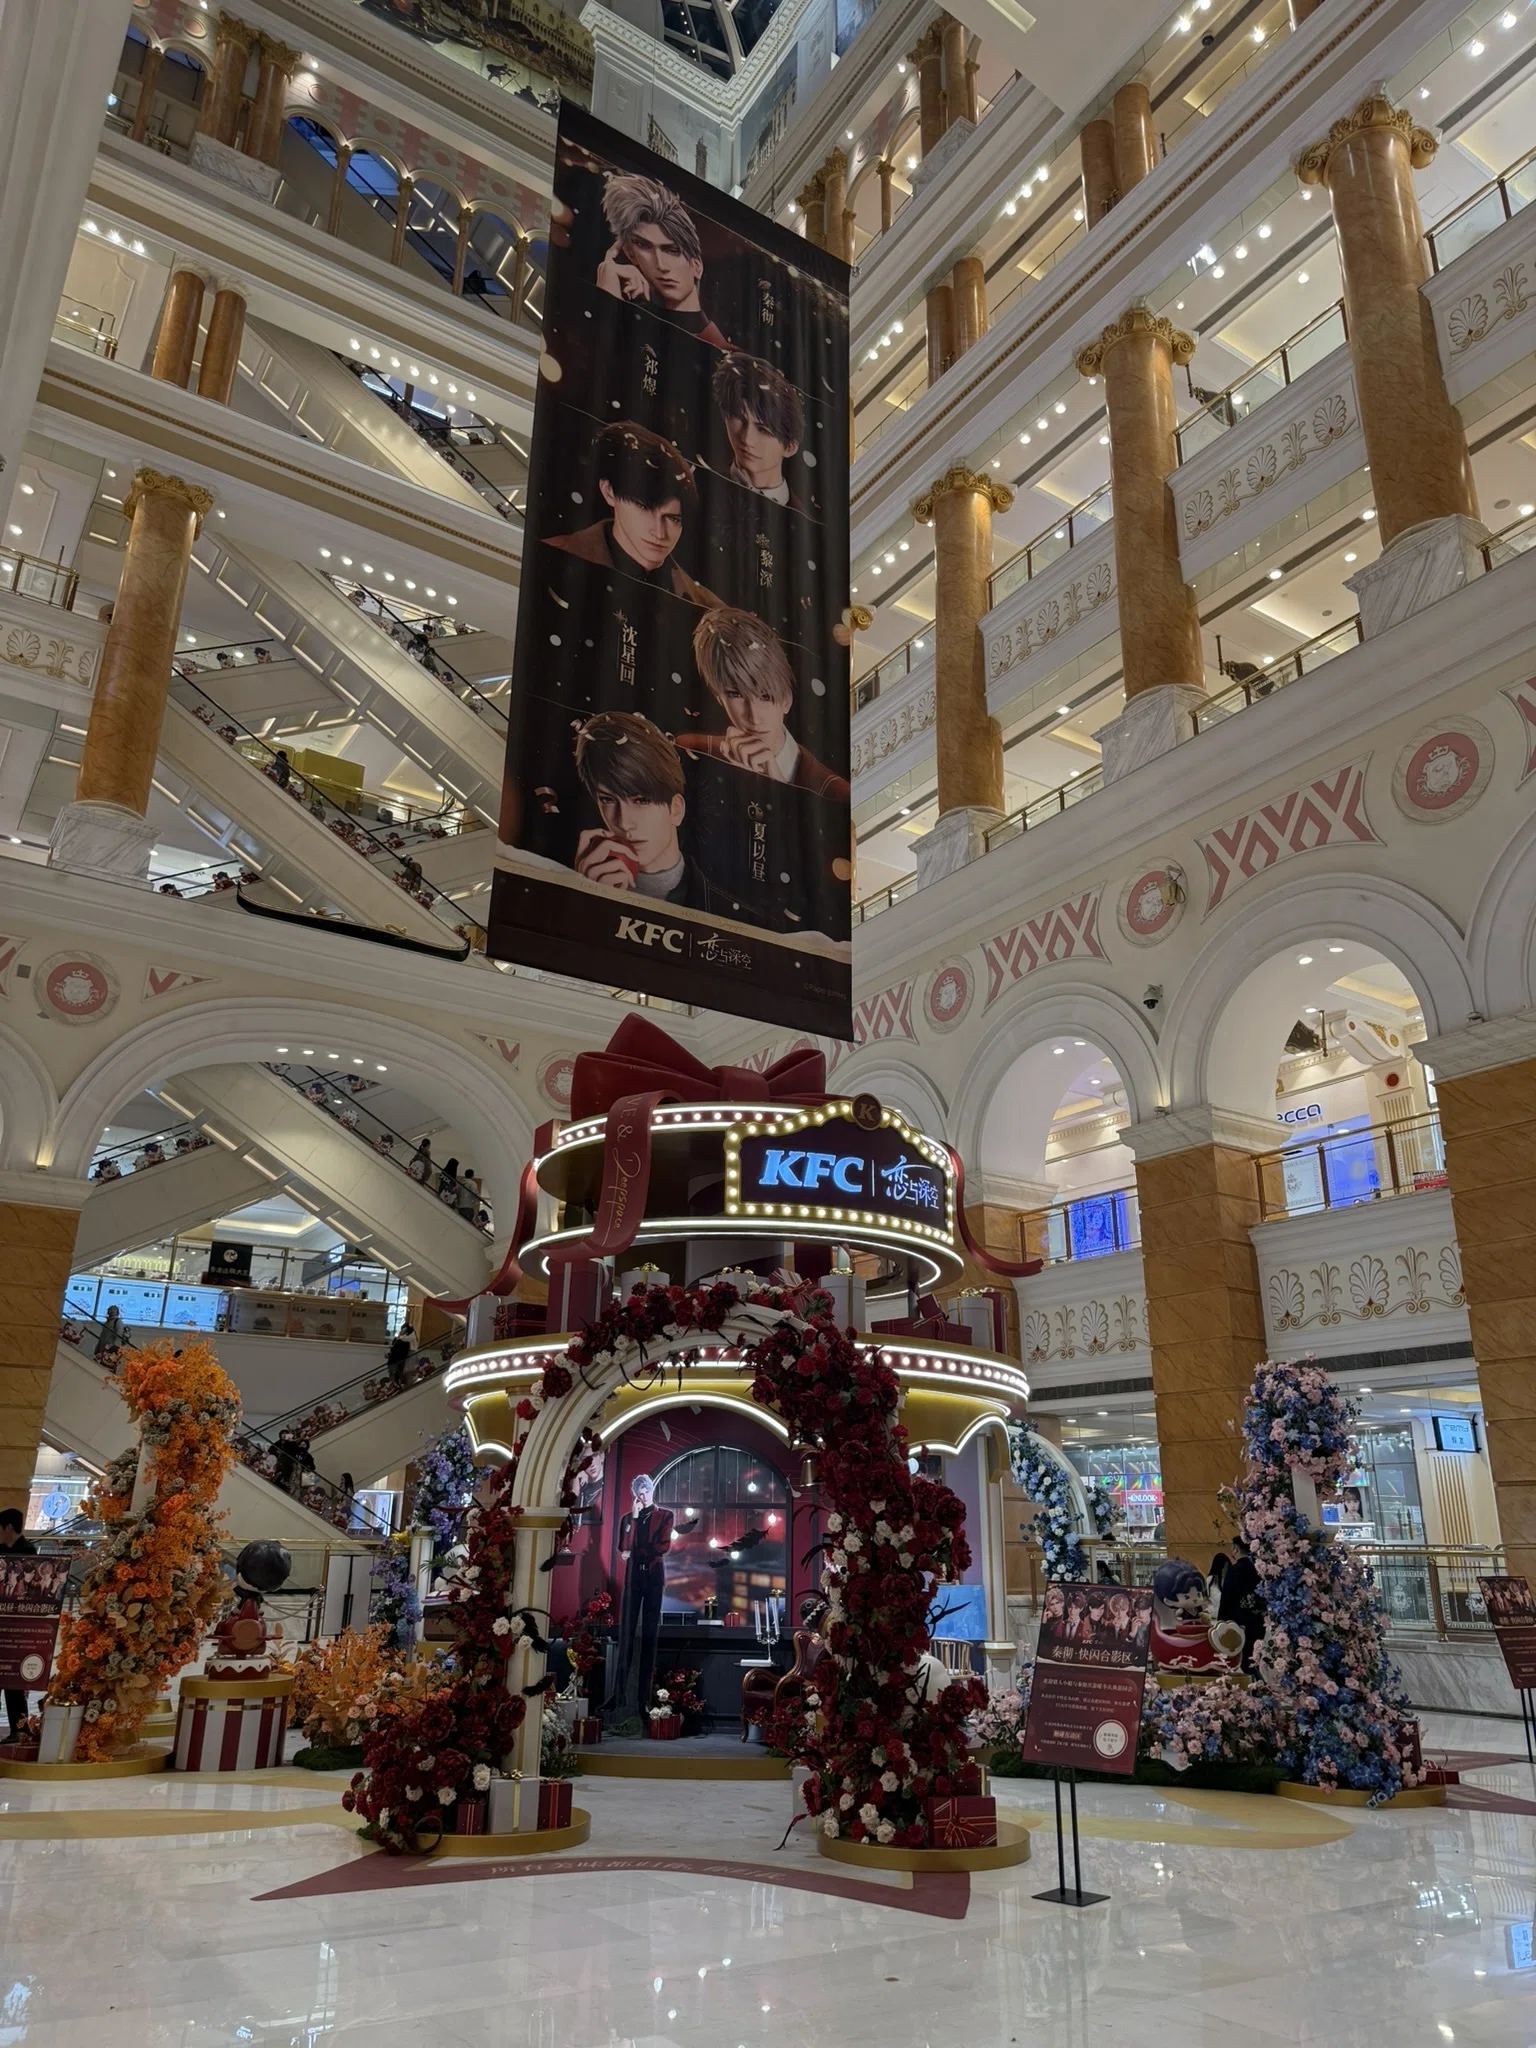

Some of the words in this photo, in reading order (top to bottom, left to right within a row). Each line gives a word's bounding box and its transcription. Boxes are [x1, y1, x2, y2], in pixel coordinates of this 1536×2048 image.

[761, 293, 775, 327] 秦彻
[760, 549, 774, 588] 黎深
[620, 624, 638, 686] 沈星回
[752, 821, 767, 882] 夏以昼
[615, 915, 685, 953] KFC
[697, 932, 752, 970] 恋与深空
[858, 1103, 875, 1122] K
[758, 1149, 865, 1193] KFC
[881, 1154, 940, 1210] 恋与深空
[1051, 1645, 1133, 1664] 秦彻·快闪合影区
